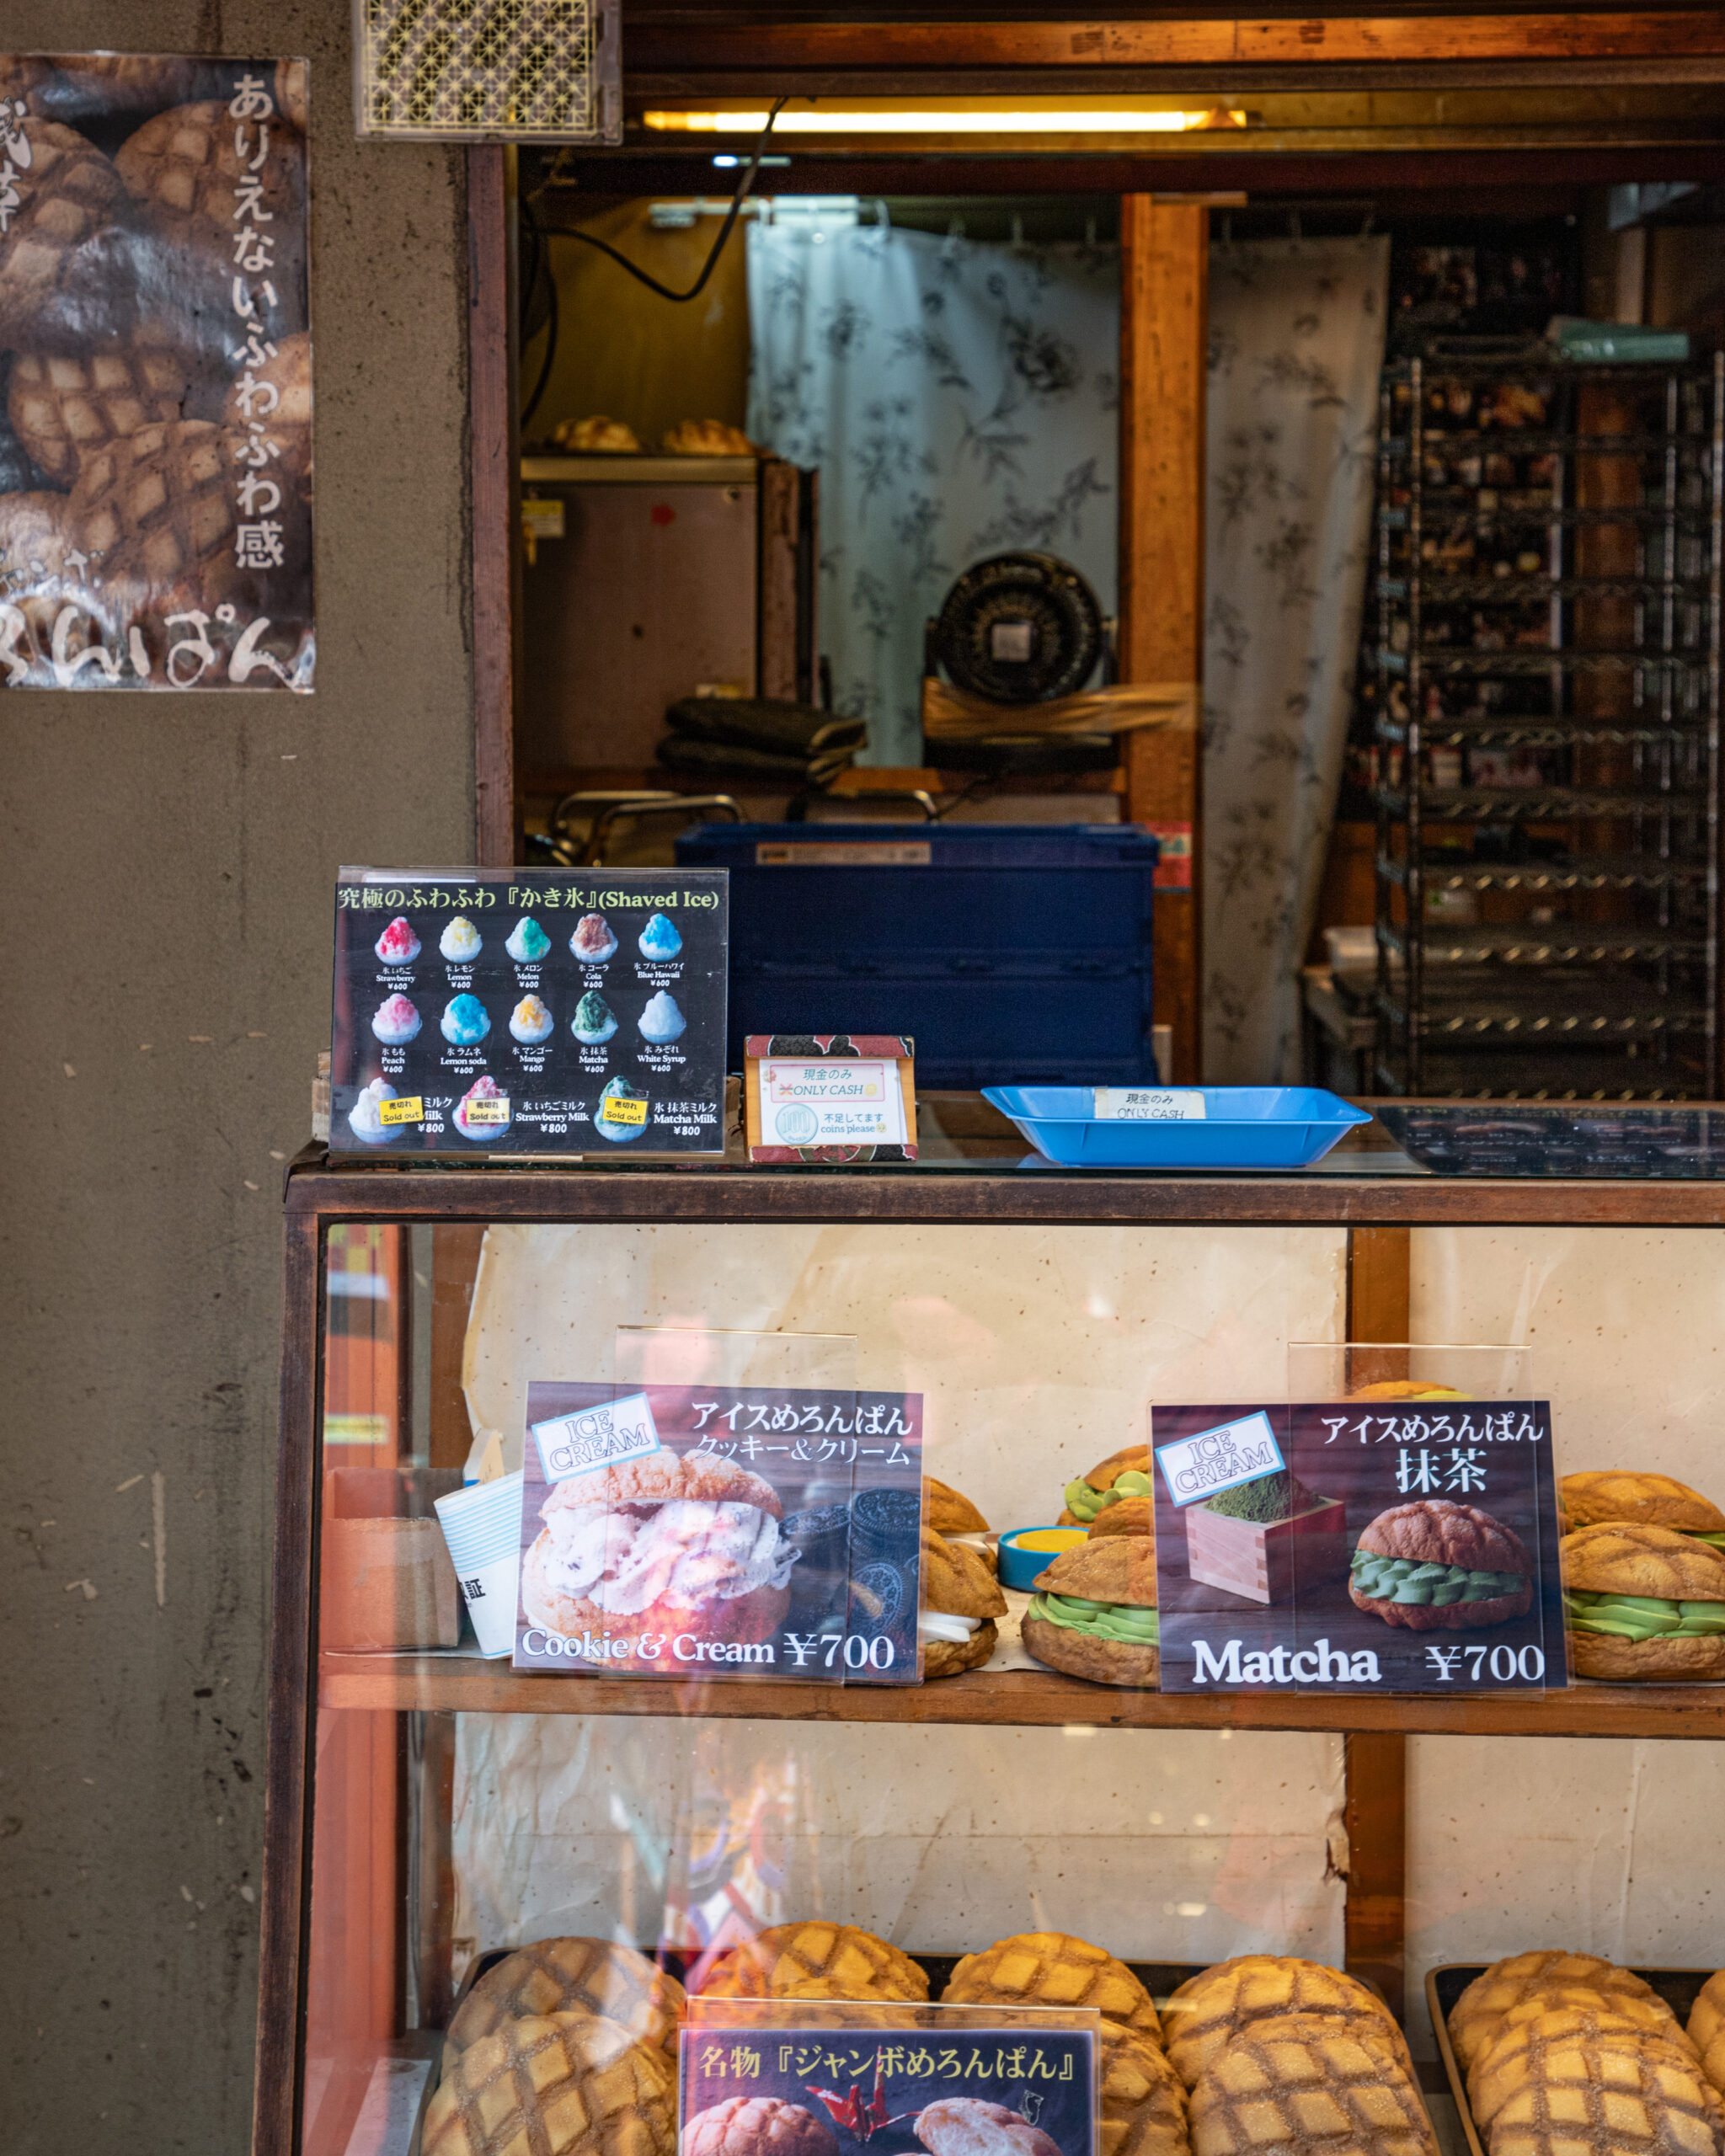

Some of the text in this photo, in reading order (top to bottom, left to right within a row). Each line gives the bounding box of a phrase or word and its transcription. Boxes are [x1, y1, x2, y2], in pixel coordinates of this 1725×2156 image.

[228, 75, 285, 569] ありえないふわふわ感
[683, 891, 718, 909] Ice)
[662, 1055, 686, 1064] Syrup
[804, 1069, 852, 1081] 現金のみ
[794, 1085, 863, 1096] ONLY CASH
[1126, 1094, 1172, 1104] 現金のみ
[615, 1101, 637, 1110] 売切れ
[515, 1113, 590, 1122] Strawberry Milk
[606, 1111, 642, 1122] Sold out
[654, 1114, 717, 1123] Matcha Milk
[825, 1113, 883, 1123] 不足してます
[1118, 1108, 1184, 1119] ONLY CASH
[418, 1123, 444, 1132] ¥800
[540, 1123, 567, 1134] ¥800
[674, 1126, 701, 1135] ¥800
[846, 1124, 875, 1134] please
[692, 1401, 913, 1436] アイスめろんぱん
[564, 1411, 613, 1443] ICE
[1321, 1412, 1544, 1444] アイスめろんぱん
[549, 1423, 650, 1471] CREAM
[1188, 1431, 1236, 1465] ICE
[1175, 1442, 1274, 1492] CREAM
[1396, 1449, 1487, 1493] 抹茶
[521, 1630, 895, 1668] Cookie & Cream ¥700
[1192, 1639, 1544, 1684] Matcha ¥700
